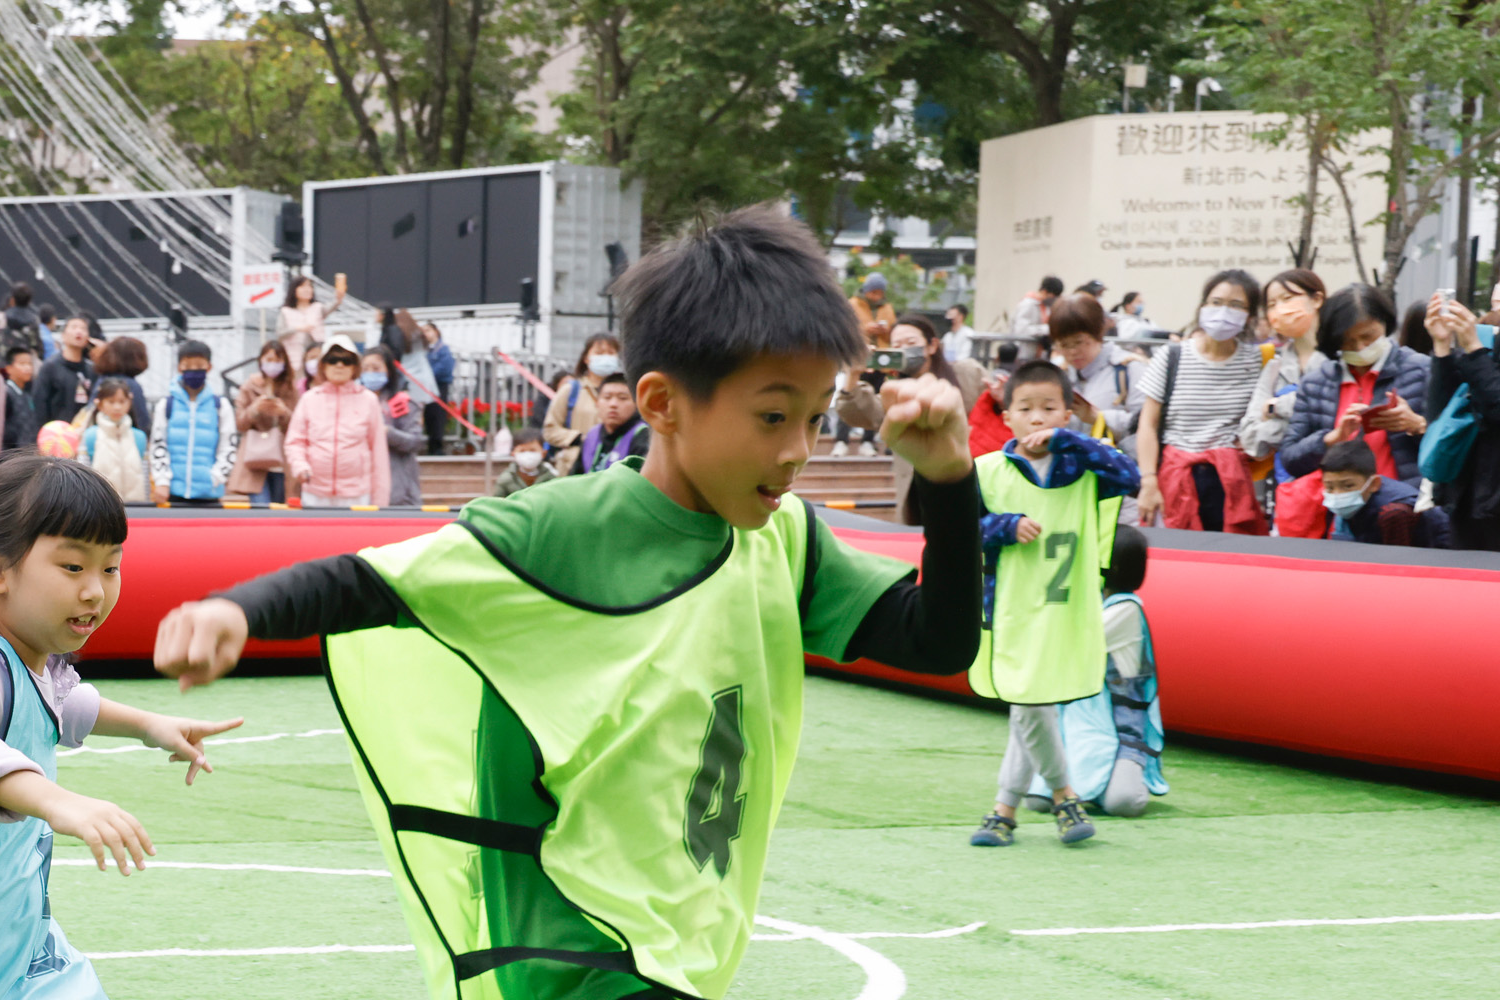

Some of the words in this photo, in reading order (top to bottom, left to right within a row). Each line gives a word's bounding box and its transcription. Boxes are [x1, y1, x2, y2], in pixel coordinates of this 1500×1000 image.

[1122, 198, 1201, 213] Welcome
[1205, 199, 1223, 211] to
[1227, 196, 1264, 210] New
[1044, 532, 1077, 605] 2
[682, 684, 748, 882] 4
